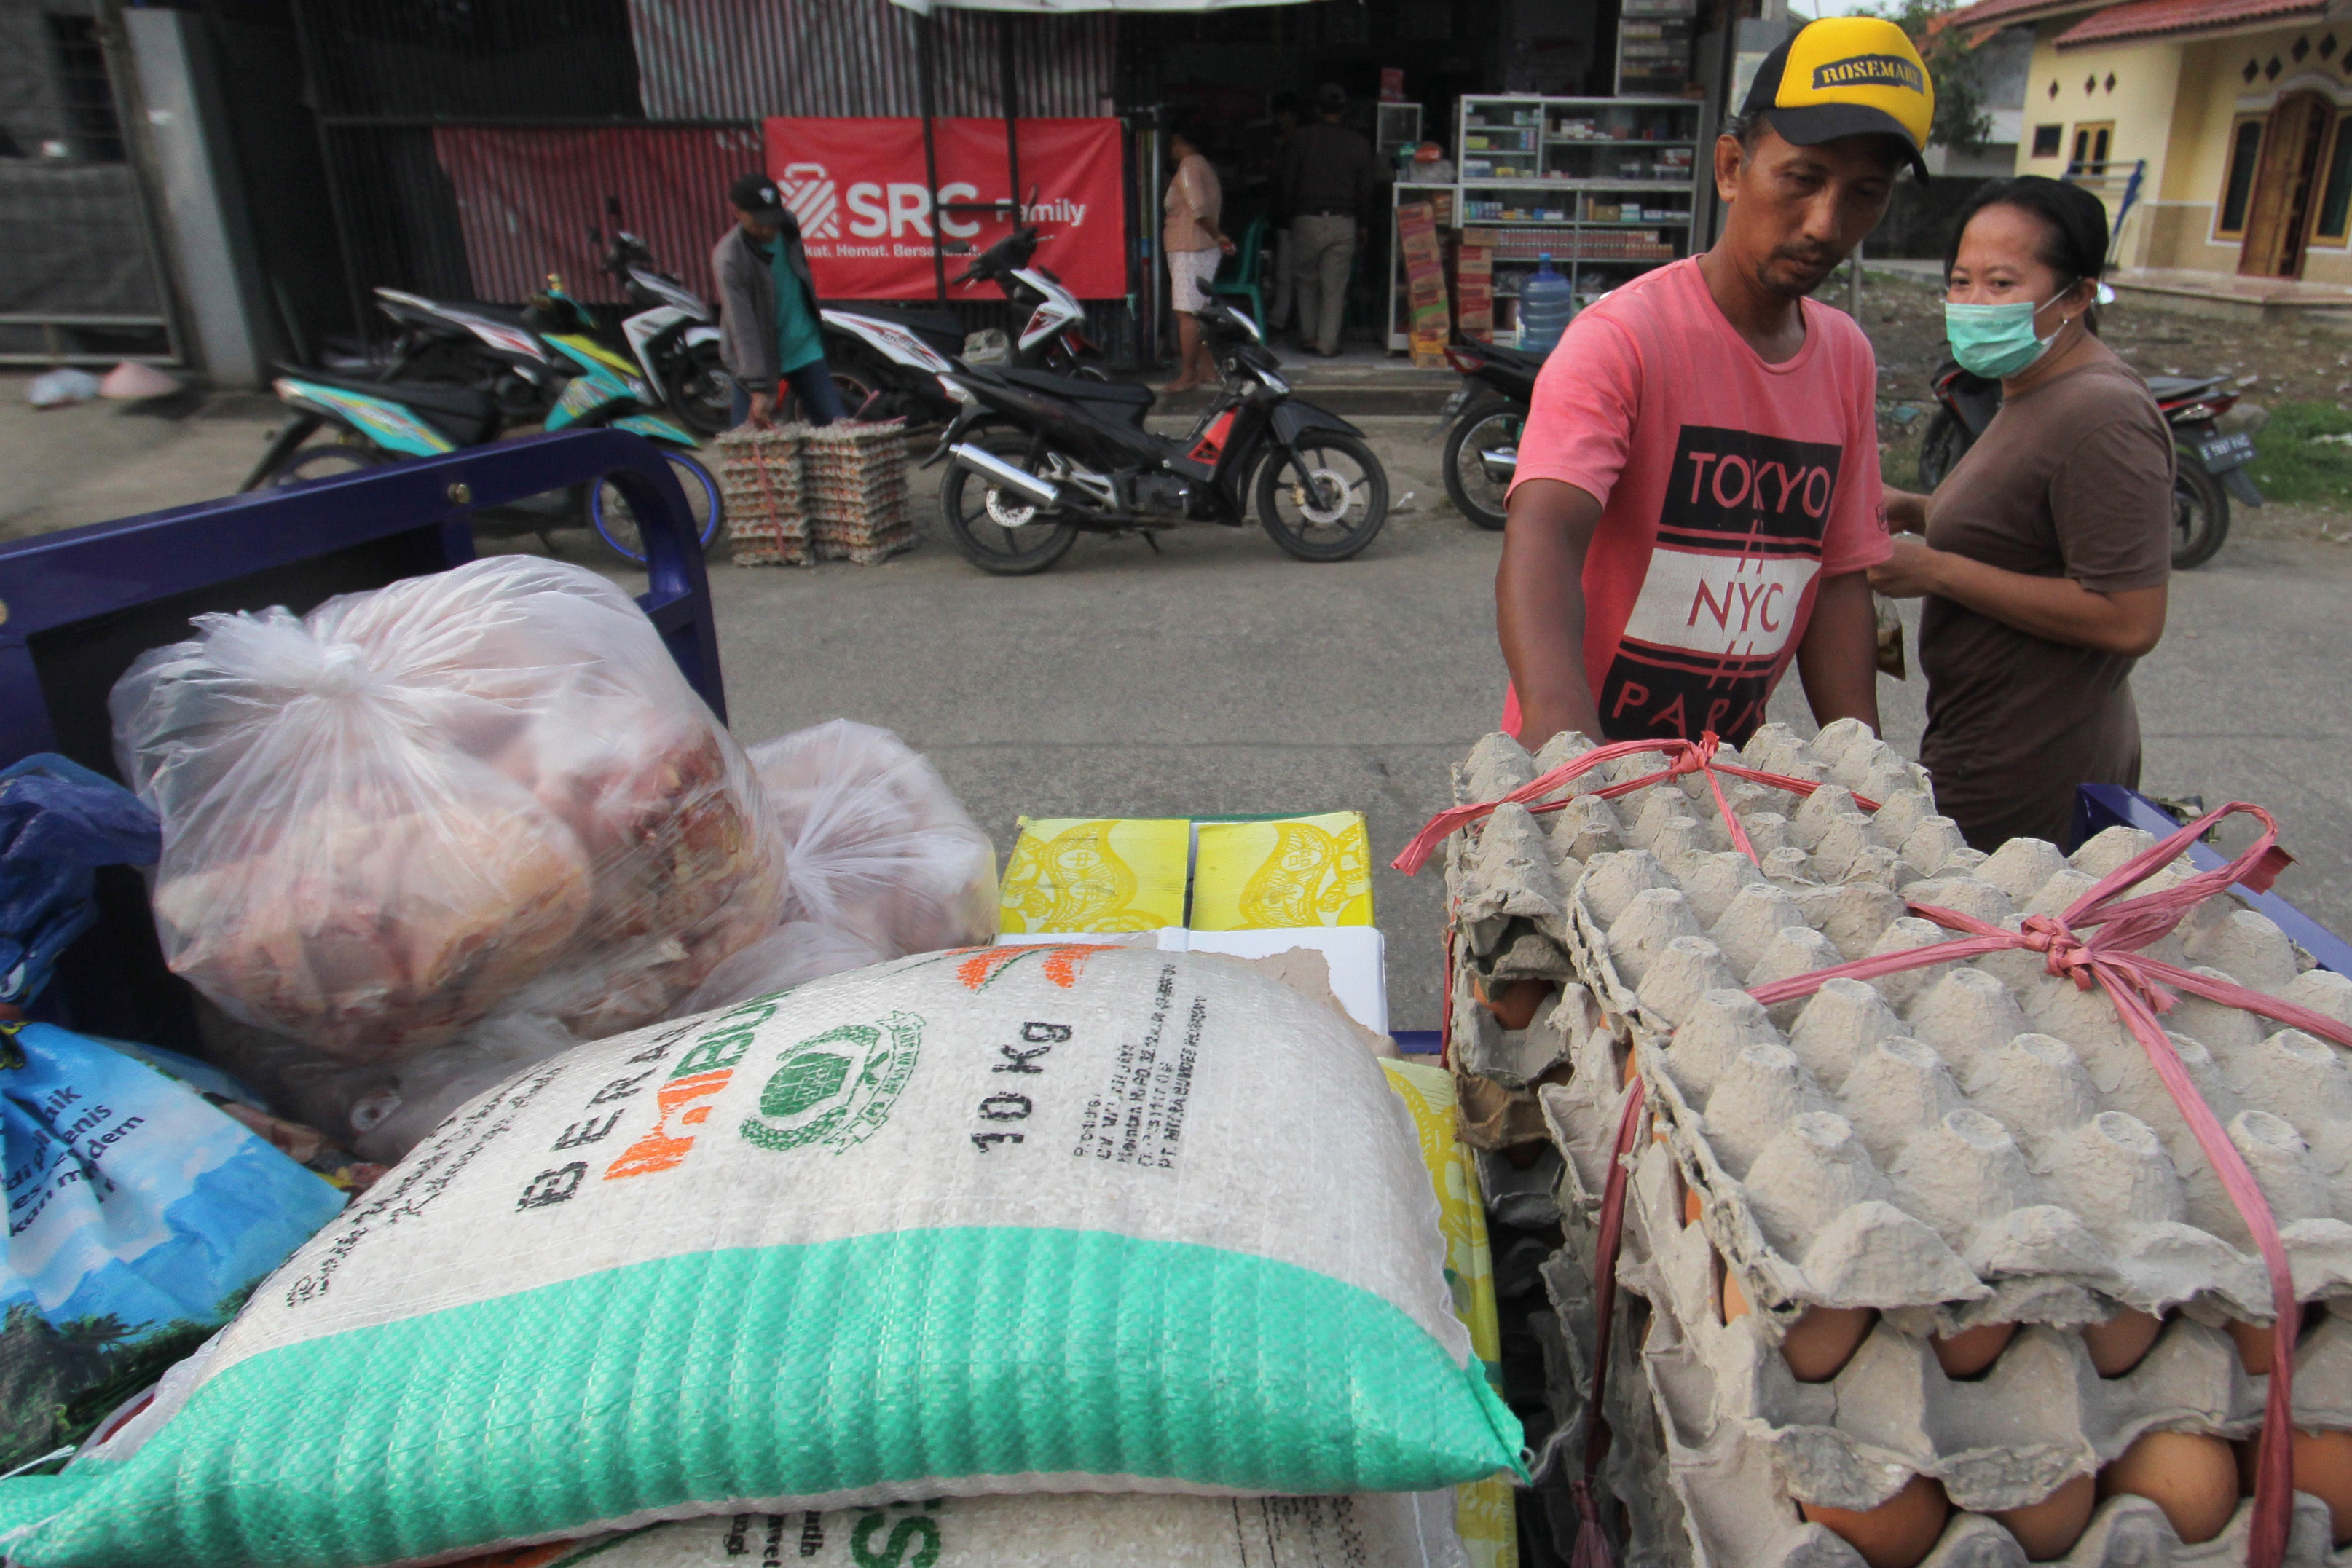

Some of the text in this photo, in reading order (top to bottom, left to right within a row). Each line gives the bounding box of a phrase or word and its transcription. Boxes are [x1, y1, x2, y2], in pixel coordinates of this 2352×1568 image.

[846, 181, 981, 238] SRC
[836, 244, 889, 257] Hemat.
[1688, 451, 1831, 518] TOKYO
[1686, 577, 1784, 633] NYC
[971, 1020, 1072, 1153] 10 Kg
[88, 1115, 145, 1160] dern
